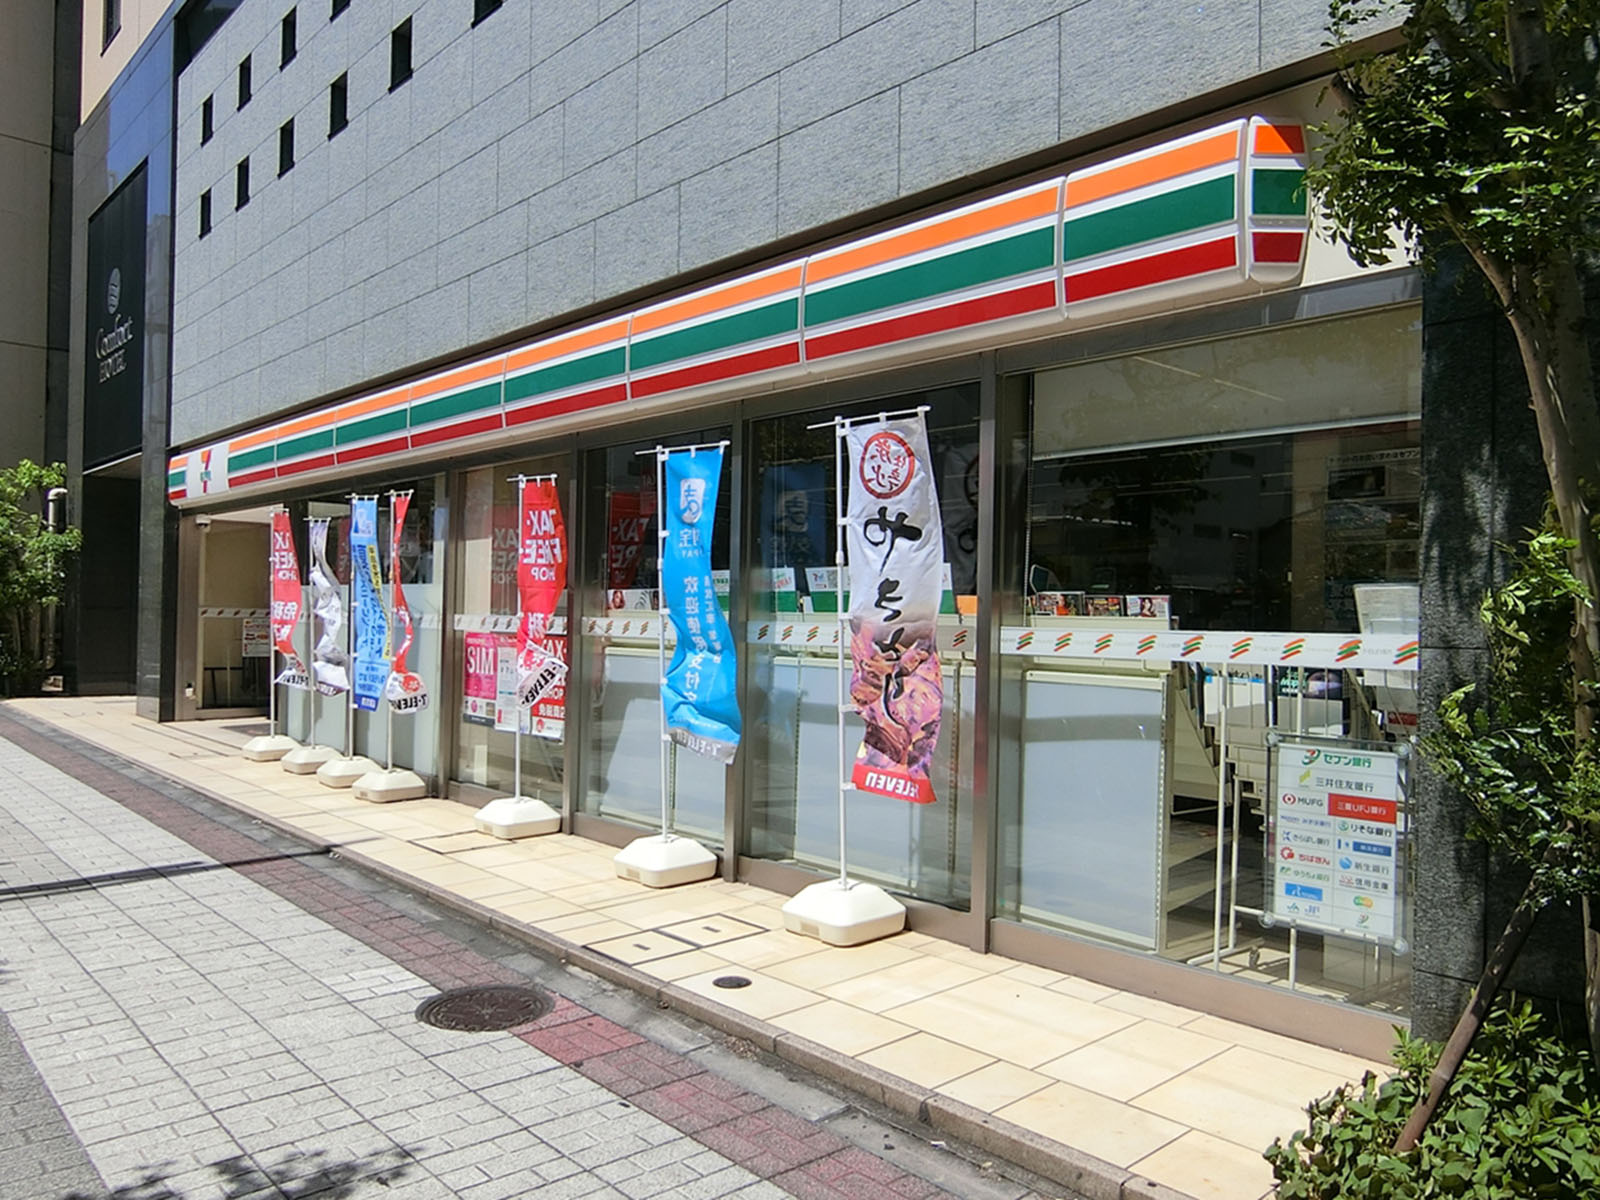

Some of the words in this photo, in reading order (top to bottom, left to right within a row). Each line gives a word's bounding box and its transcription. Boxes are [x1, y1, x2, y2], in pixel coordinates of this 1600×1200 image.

[96, 314, 134, 360] Comfort
[466, 646, 494, 675] SIM
[1324, 754, 1372, 768] セブン銀行
[1315, 776, 1374, 793] 三井住友銀行
[1297, 796, 1324, 807] MUFG
[1337, 801, 1387, 816] 三菱UFJ銀行
[1350, 823, 1392, 838] りそな銀行
[1293, 833, 1330, 847] きらぼし銀行
[1293, 869, 1330, 882] ゆうちょ銀行
[1354, 861, 1390, 876] 新生銀行
[1355, 877, 1389, 891] 信用金庫
